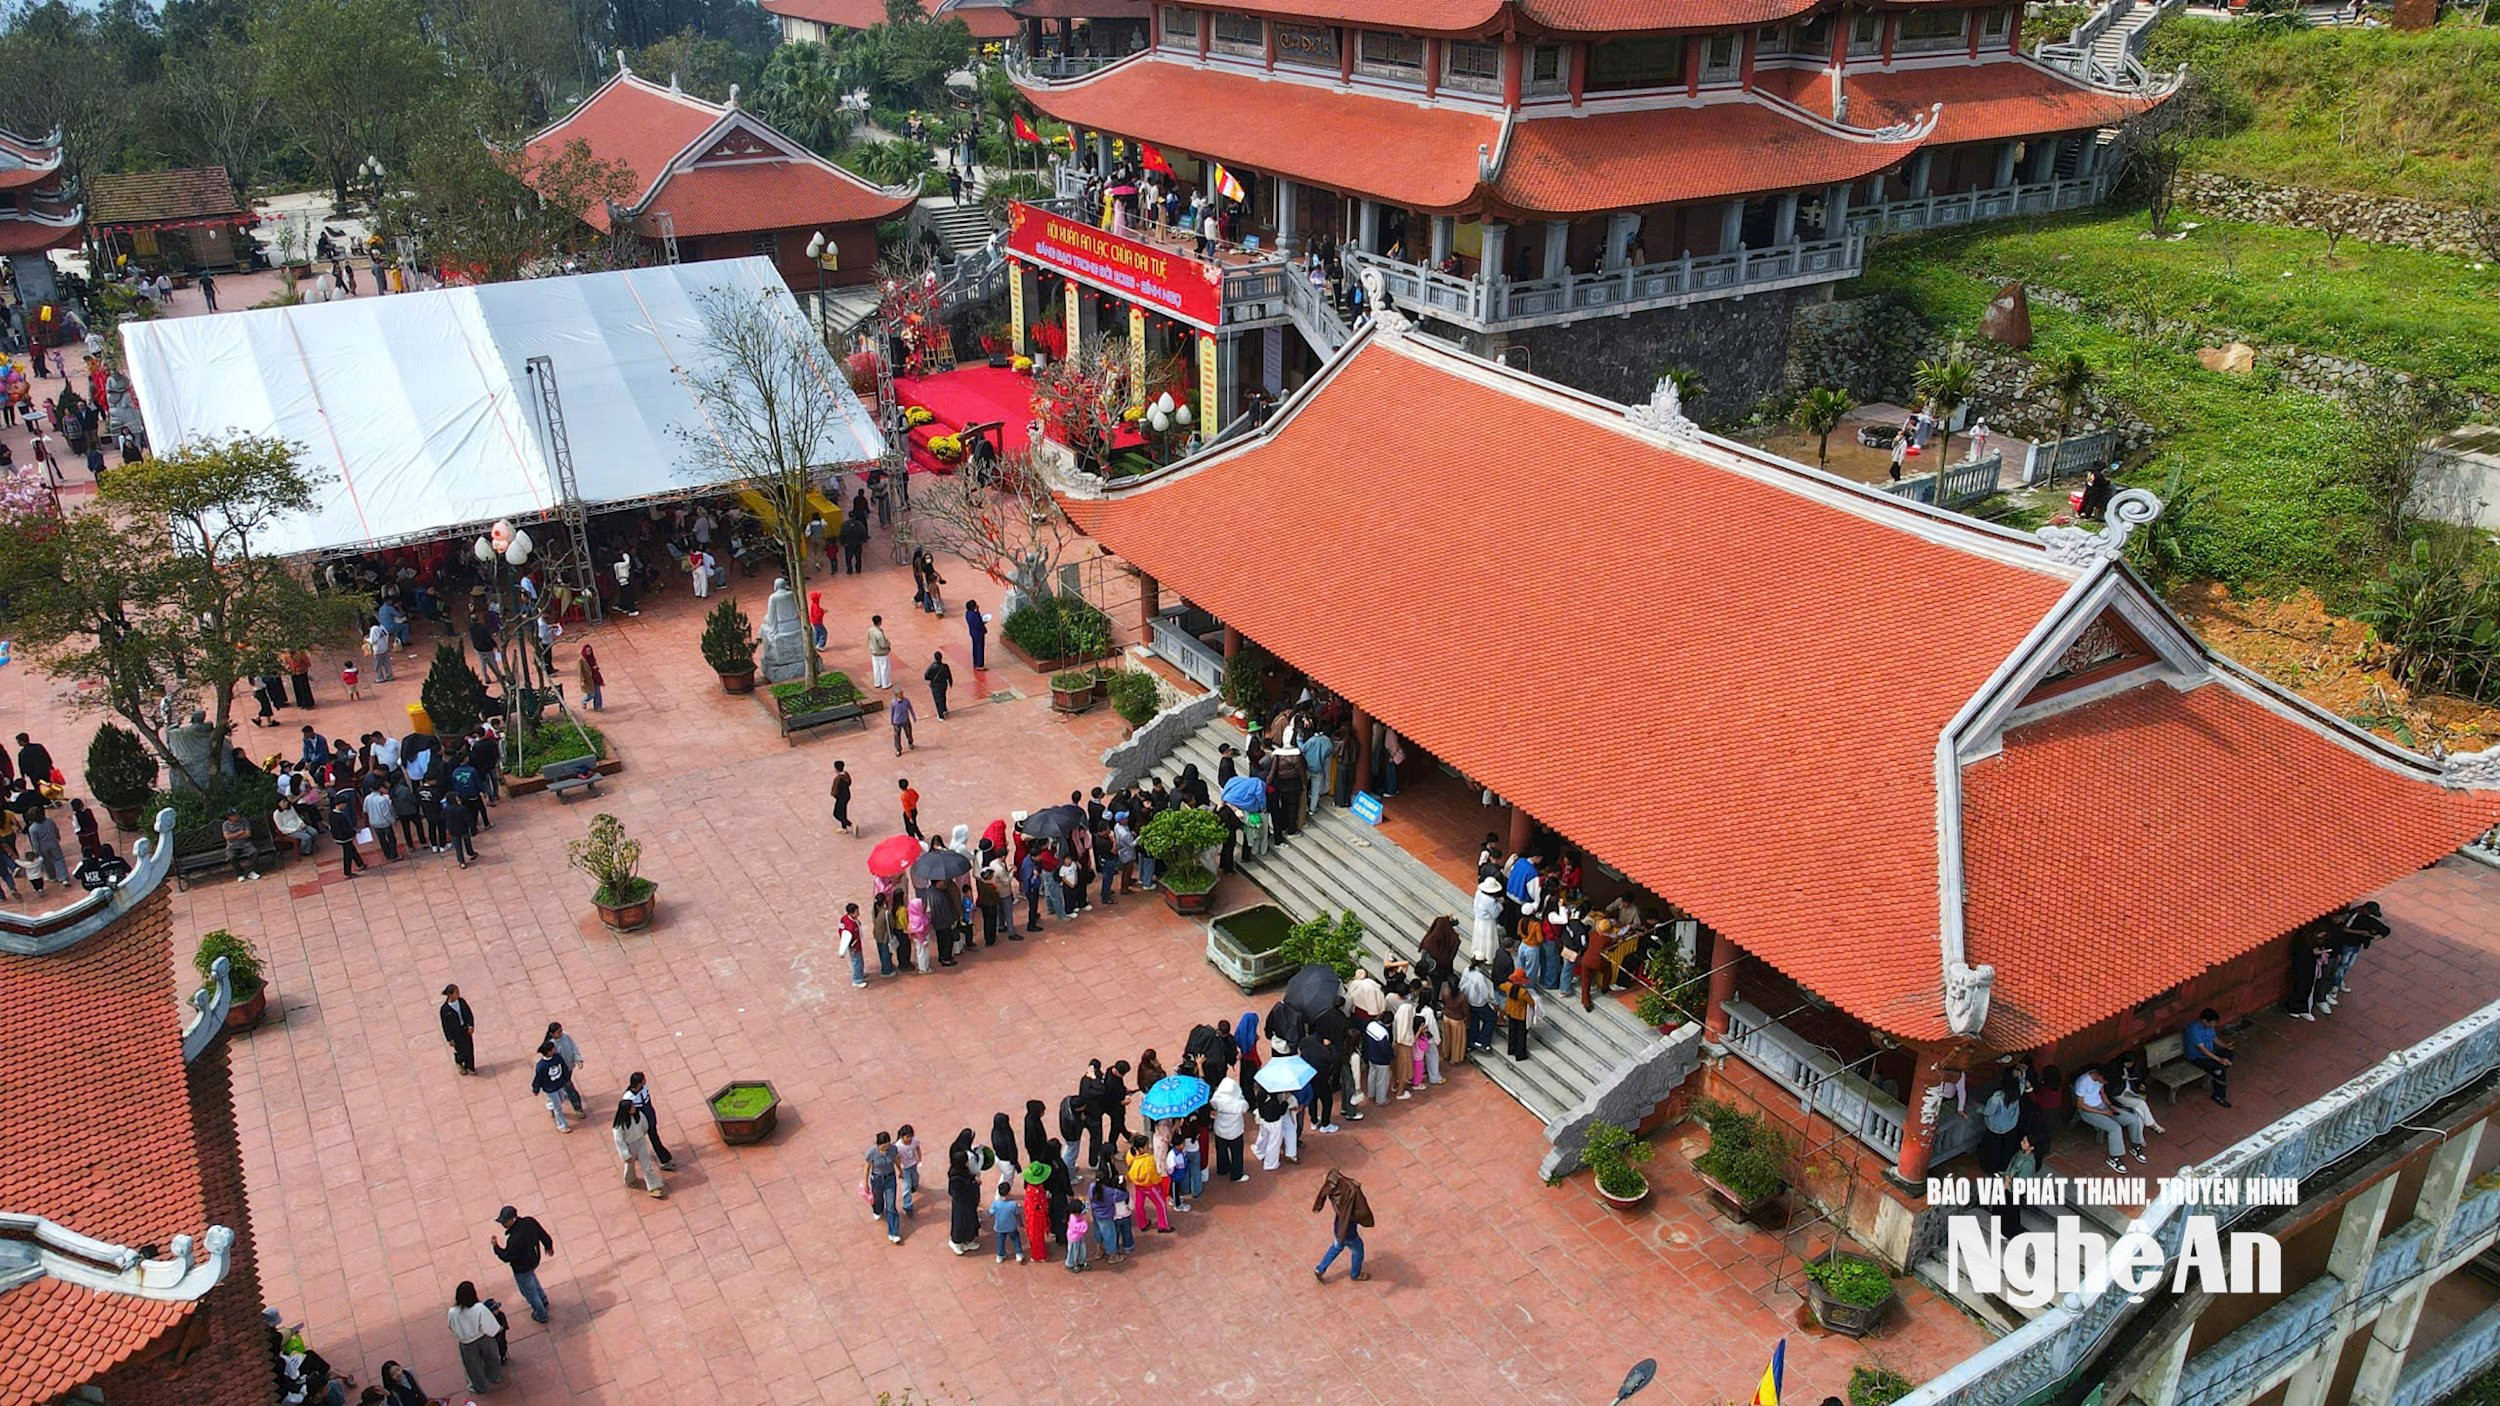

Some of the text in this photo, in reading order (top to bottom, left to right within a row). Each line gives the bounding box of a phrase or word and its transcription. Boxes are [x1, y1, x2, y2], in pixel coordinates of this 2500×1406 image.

[1047, 220, 1167, 282] HỘI XUÂN AN LẠC CHÙA ĐẠI TUỆ
